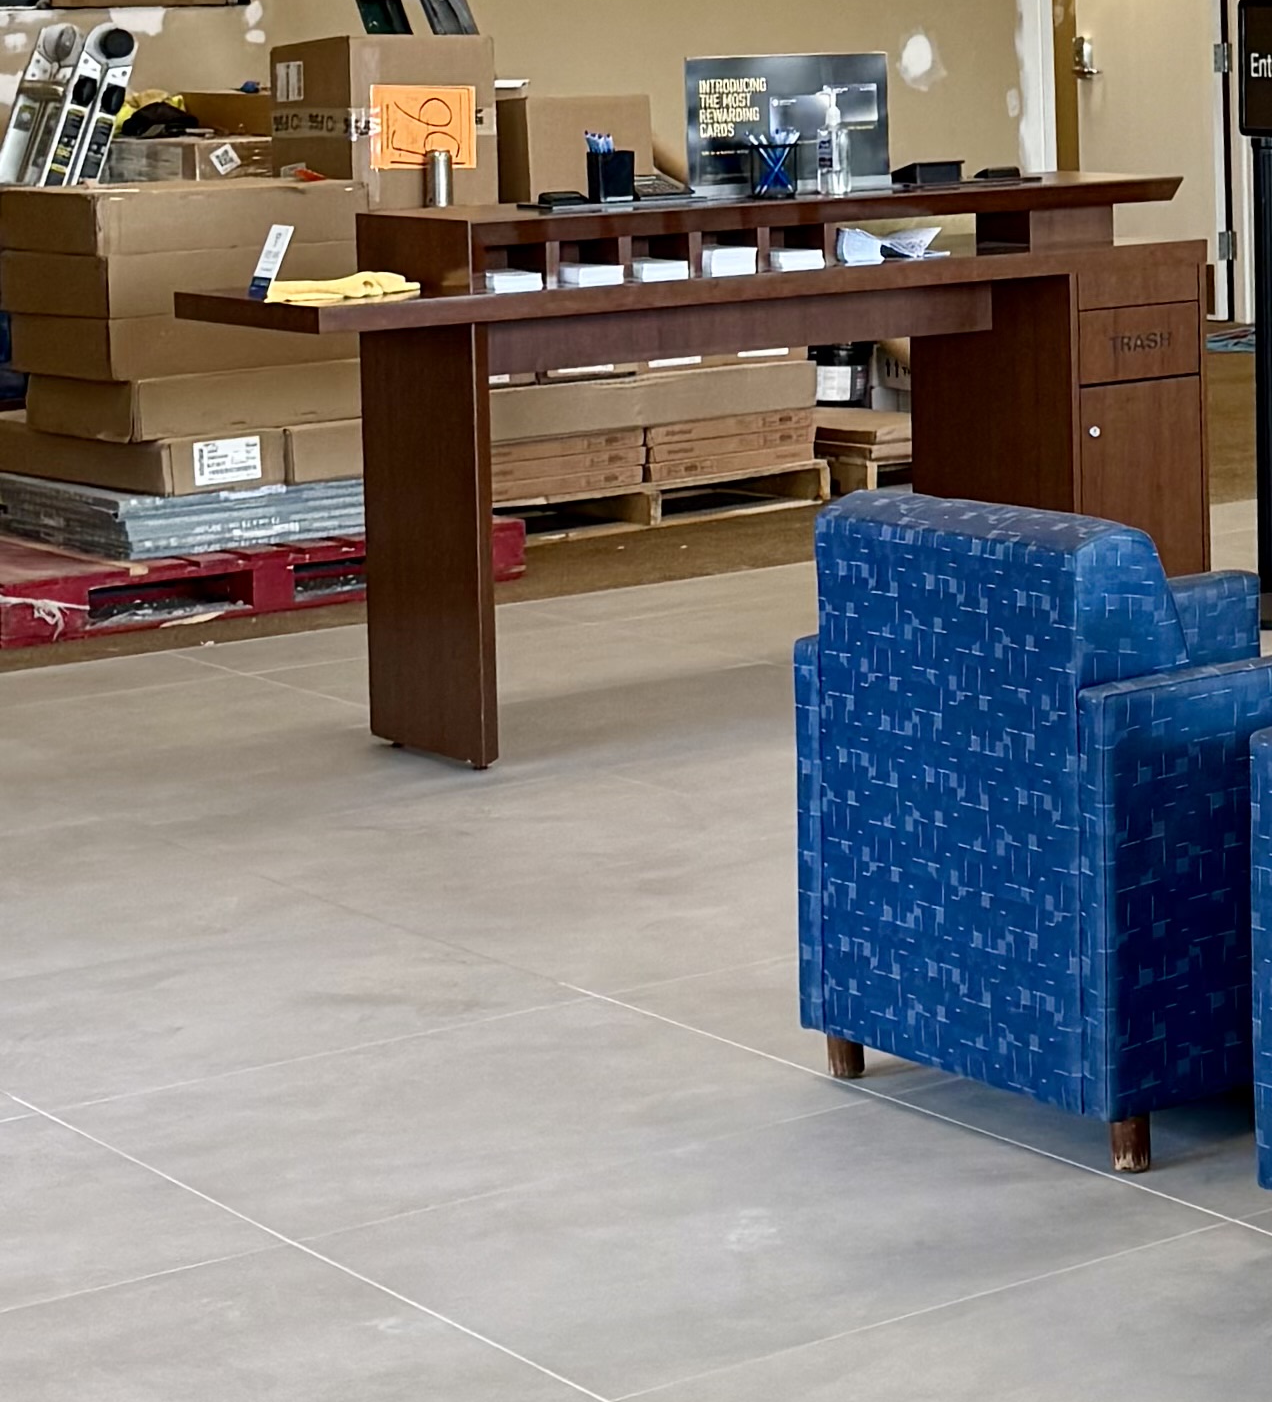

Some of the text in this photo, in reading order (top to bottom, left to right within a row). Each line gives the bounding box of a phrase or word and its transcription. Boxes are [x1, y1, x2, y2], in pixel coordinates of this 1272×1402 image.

[699, 77, 767, 94] INTRODUCING
[699, 92, 752, 108] THE MOST
[699, 107, 760, 124] REWARDING
[700, 122, 735, 138] CARDS
[1109, 331, 1172, 355] TRASH
